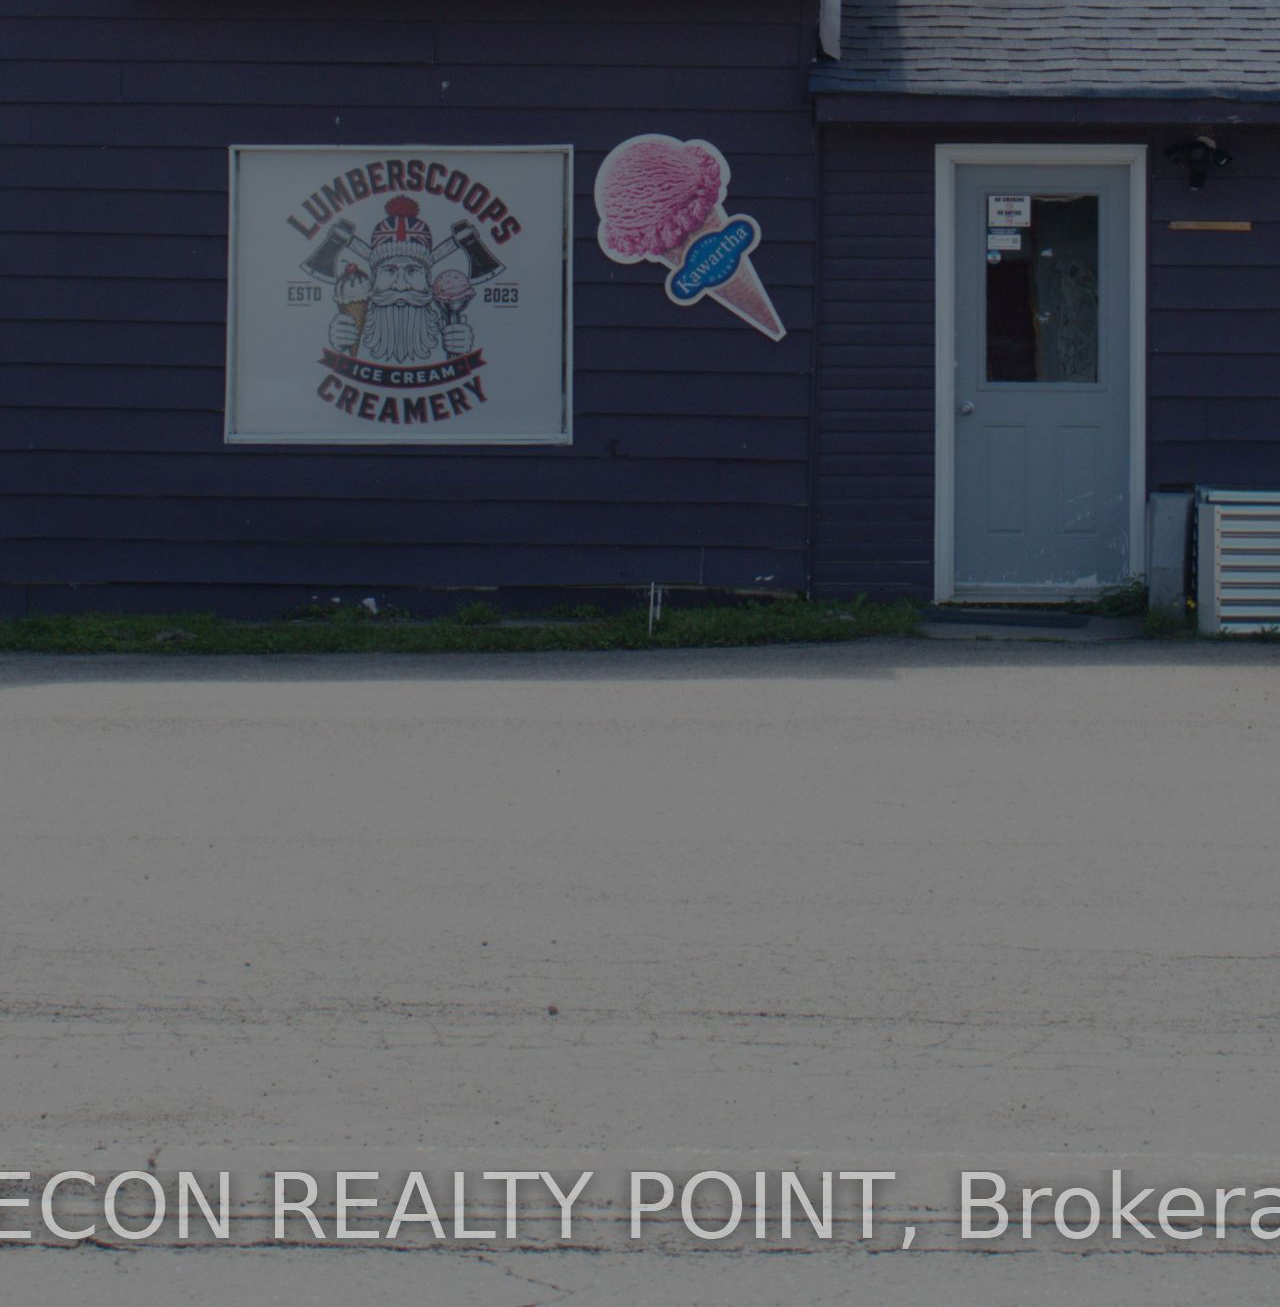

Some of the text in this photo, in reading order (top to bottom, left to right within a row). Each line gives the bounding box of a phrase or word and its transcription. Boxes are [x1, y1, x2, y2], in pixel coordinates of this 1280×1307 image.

[287, 159, 523, 245] LUMBERSCOOPS
[676, 228, 749, 295] Kawartha
[287, 286, 519, 303] ESTD 2023
[317, 373, 488, 425] CREAMERY
[352, 364, 456, 385] ICE CREAM
